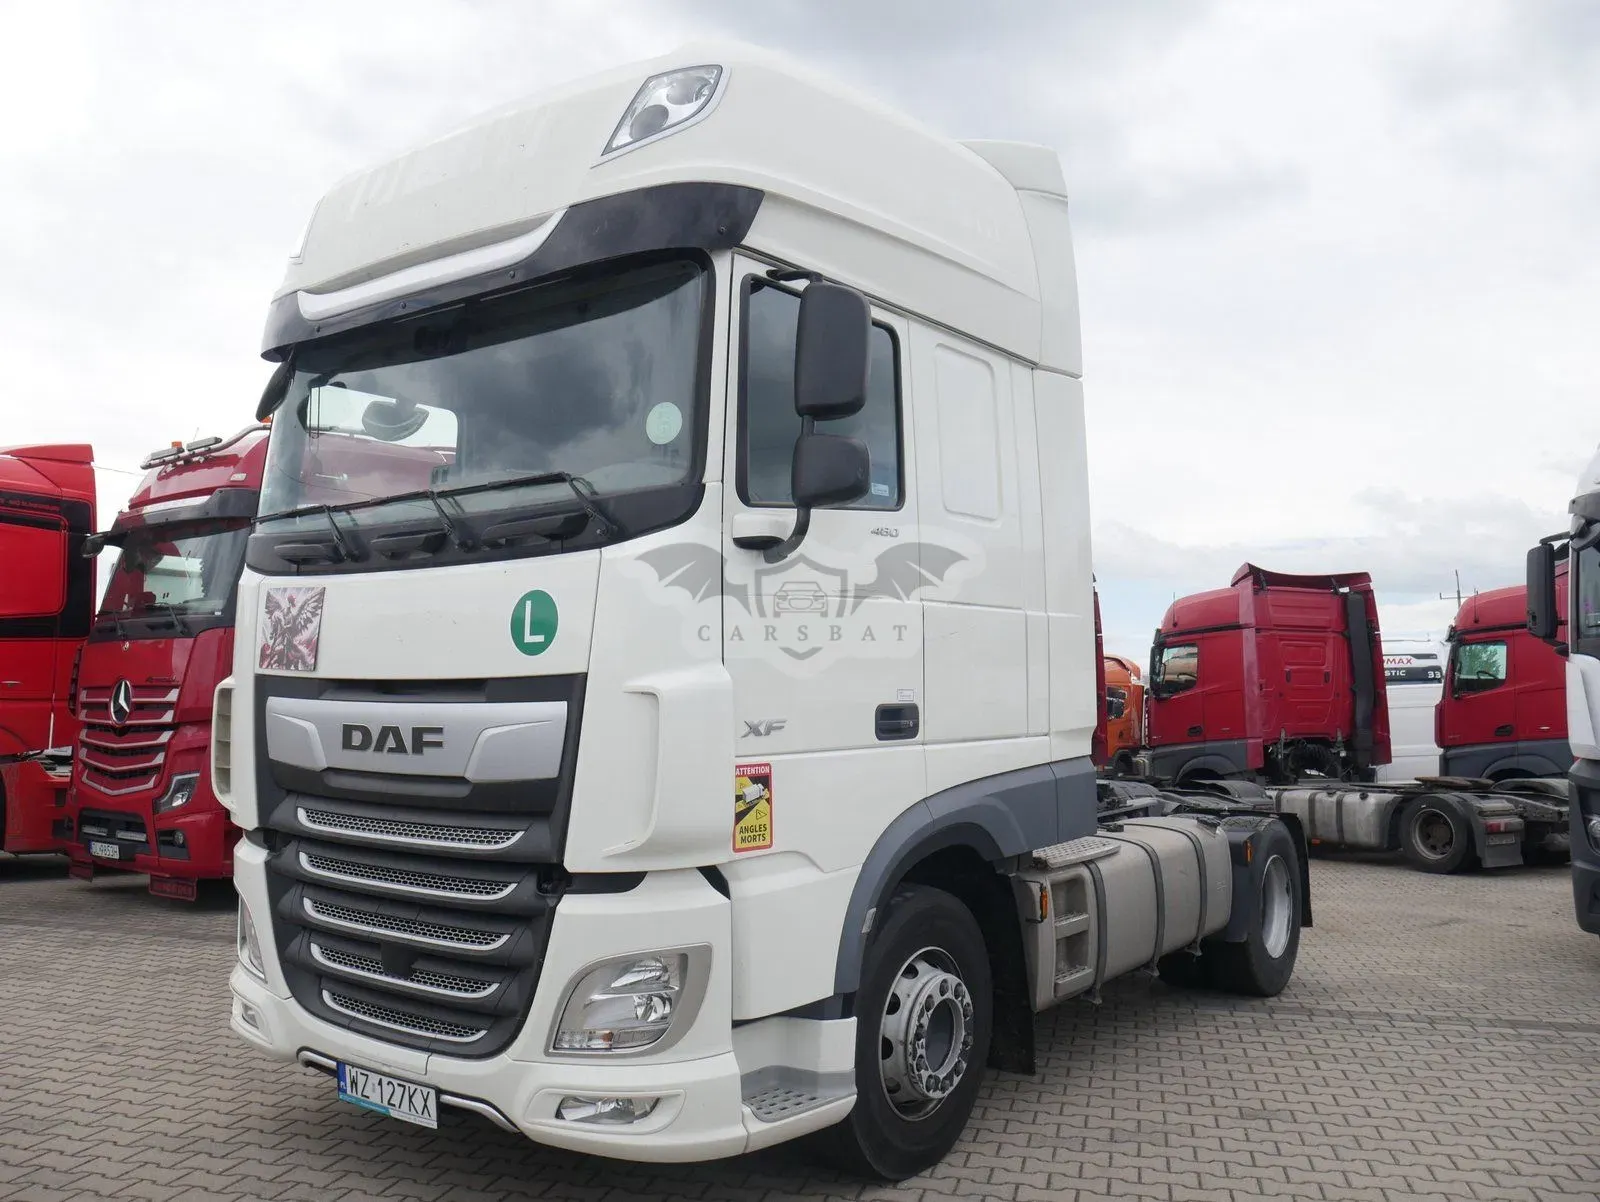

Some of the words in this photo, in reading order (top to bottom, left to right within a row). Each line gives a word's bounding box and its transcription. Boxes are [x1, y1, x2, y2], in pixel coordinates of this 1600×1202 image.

[870, 527, 899, 538] 460
[523, 600, 545, 643] L
[1427, 671, 1441, 679] 33
[741, 718, 788, 738] XF
[341, 723, 445, 755] DAF
[735, 765, 770, 775] ATTENTION
[739, 823, 768, 835] ANGLES
[740, 833, 766, 844] MORTS
[348, 1067, 370, 1099] WZ
[378, 1077, 432, 1118] 127KX
